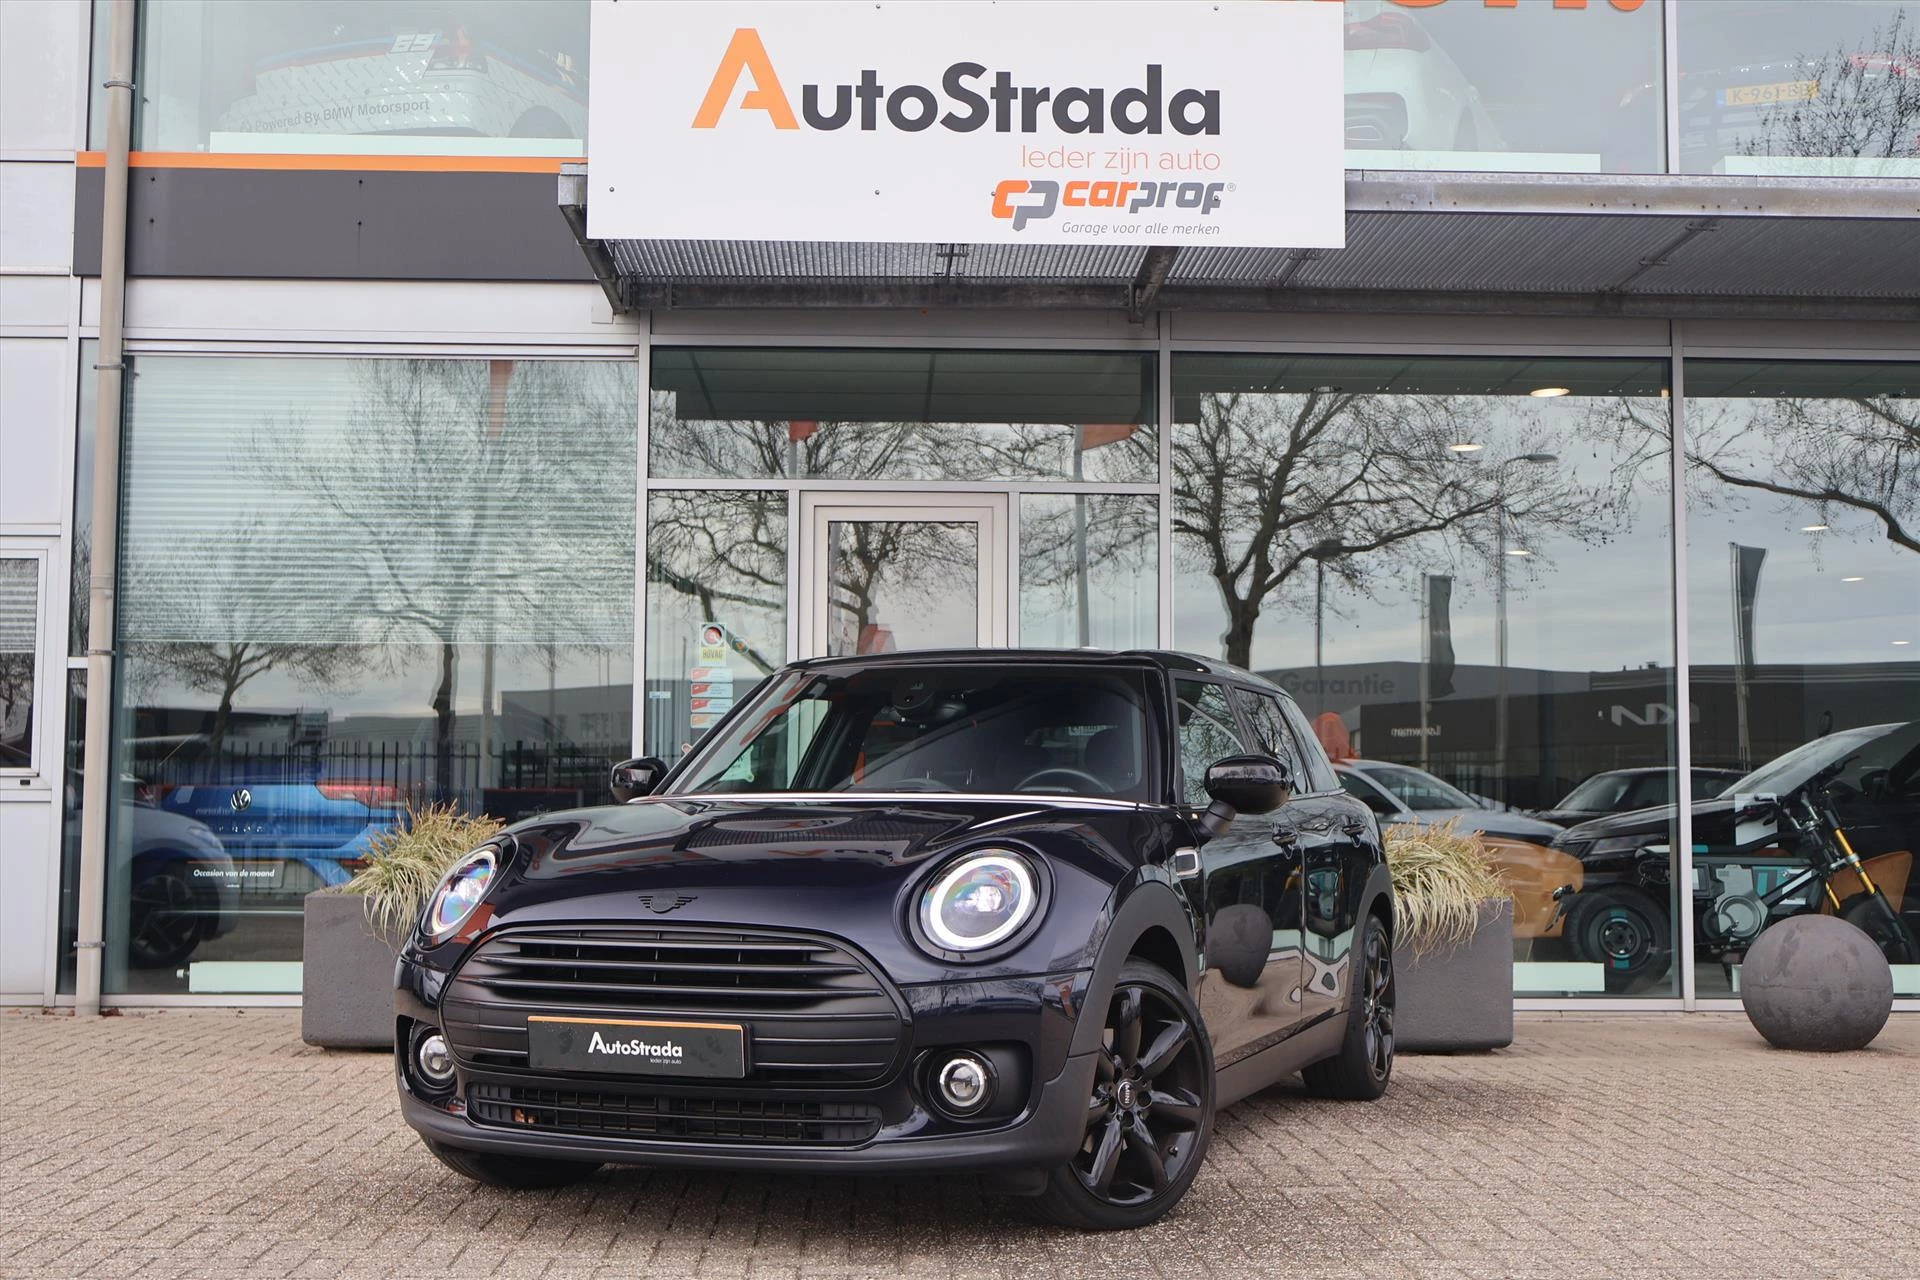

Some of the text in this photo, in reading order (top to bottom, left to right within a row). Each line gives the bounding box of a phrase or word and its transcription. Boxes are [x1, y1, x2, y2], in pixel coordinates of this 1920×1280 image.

[691, 28, 1220, 135] AutoStrada
[255, 111, 301, 131] Powered
[304, 111, 320, 126] By
[323, 104, 354, 121] BMW
[357, 99, 431, 116] Motorsport
[1104, 147, 1149, 176] zijn
[1159, 149, 1221, 171] auto
[1062, 180, 1225, 215] carprof
[1062, 221, 1221, 235] Garage voor alle merken
[1280, 672, 1395, 695] Garantie
[193, 869, 224, 877] Occasion
[240, 869, 249, 877] de
[249, 869, 275, 877] maand
[588, 1031, 682, 1057] AutoStrada
